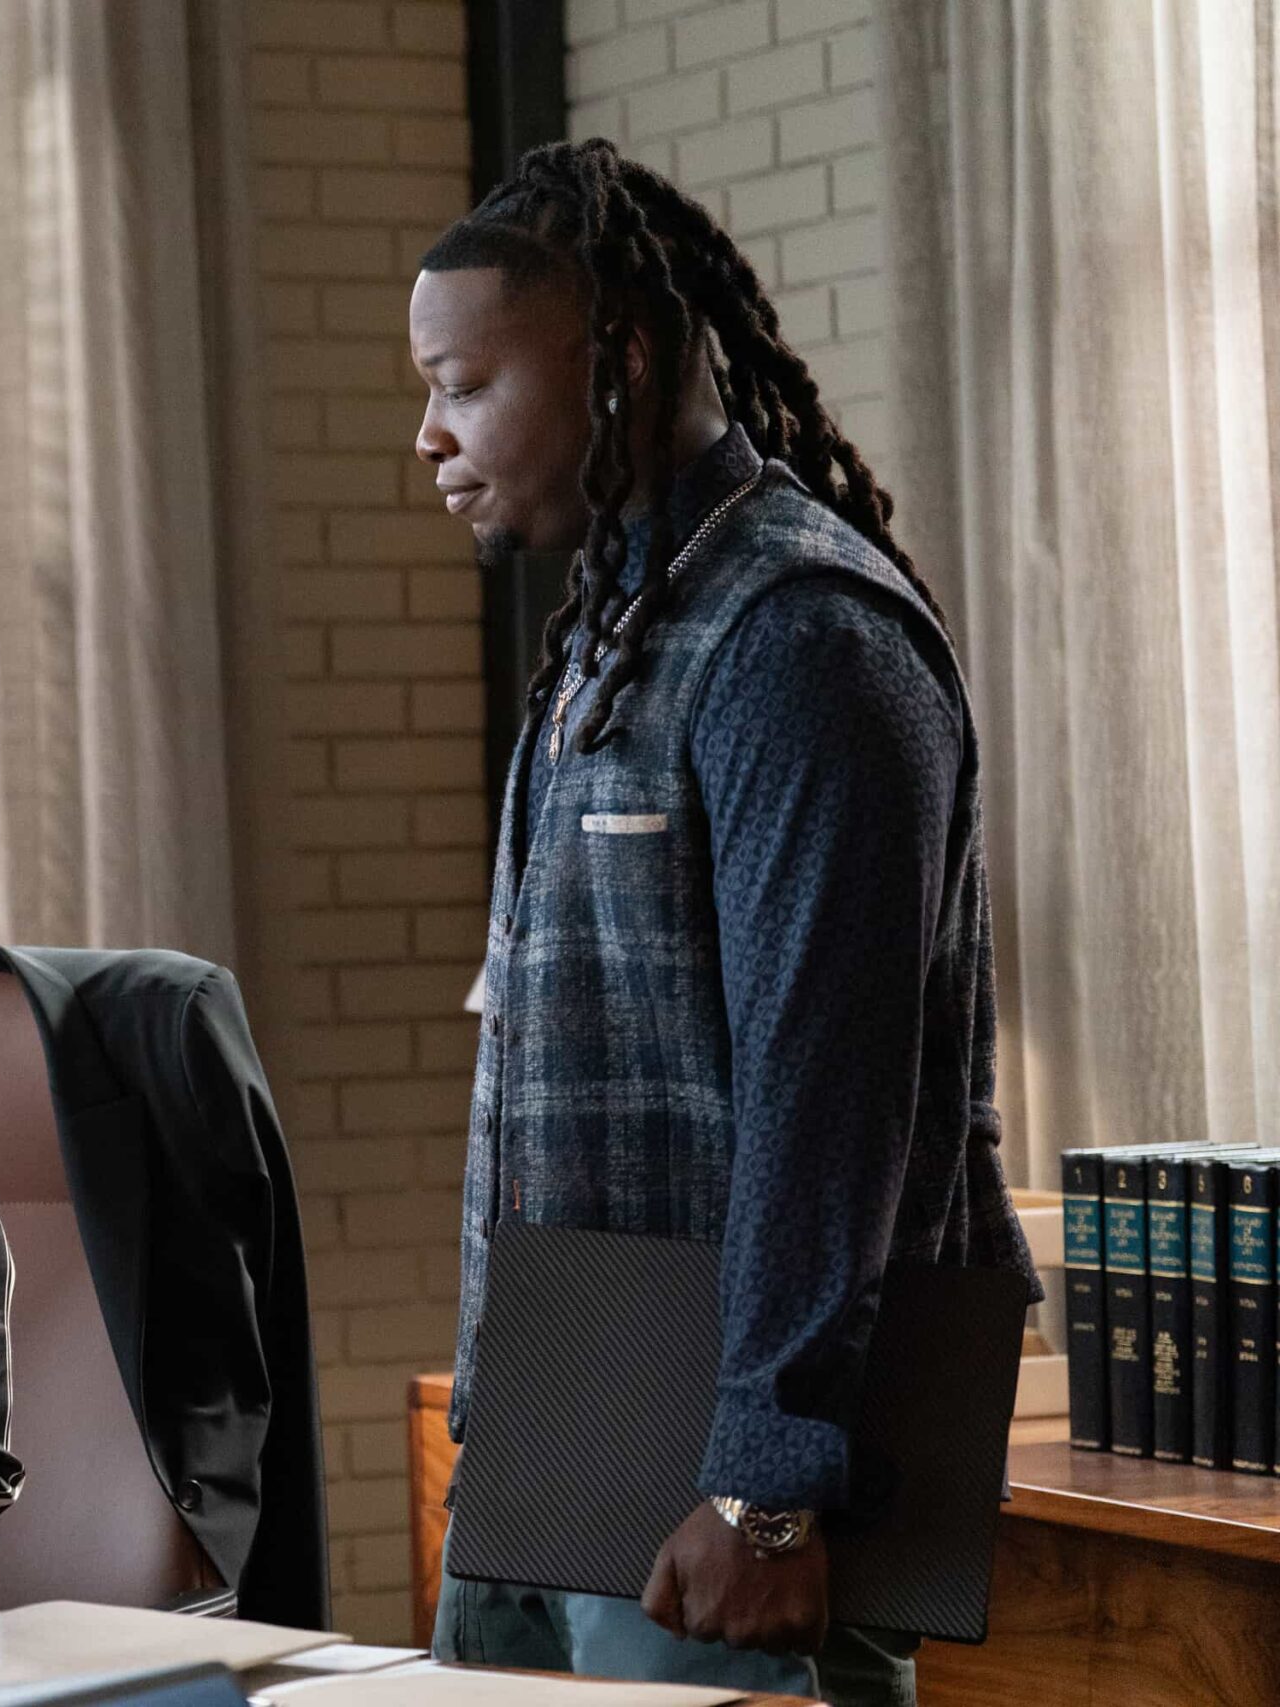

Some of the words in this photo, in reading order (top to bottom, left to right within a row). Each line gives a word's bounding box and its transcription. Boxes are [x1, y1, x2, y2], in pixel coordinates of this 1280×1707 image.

[1118, 1168, 1128, 1189] 2
[1158, 1168, 1168, 1190] 3
[1243, 1174, 1253, 1195] 6
